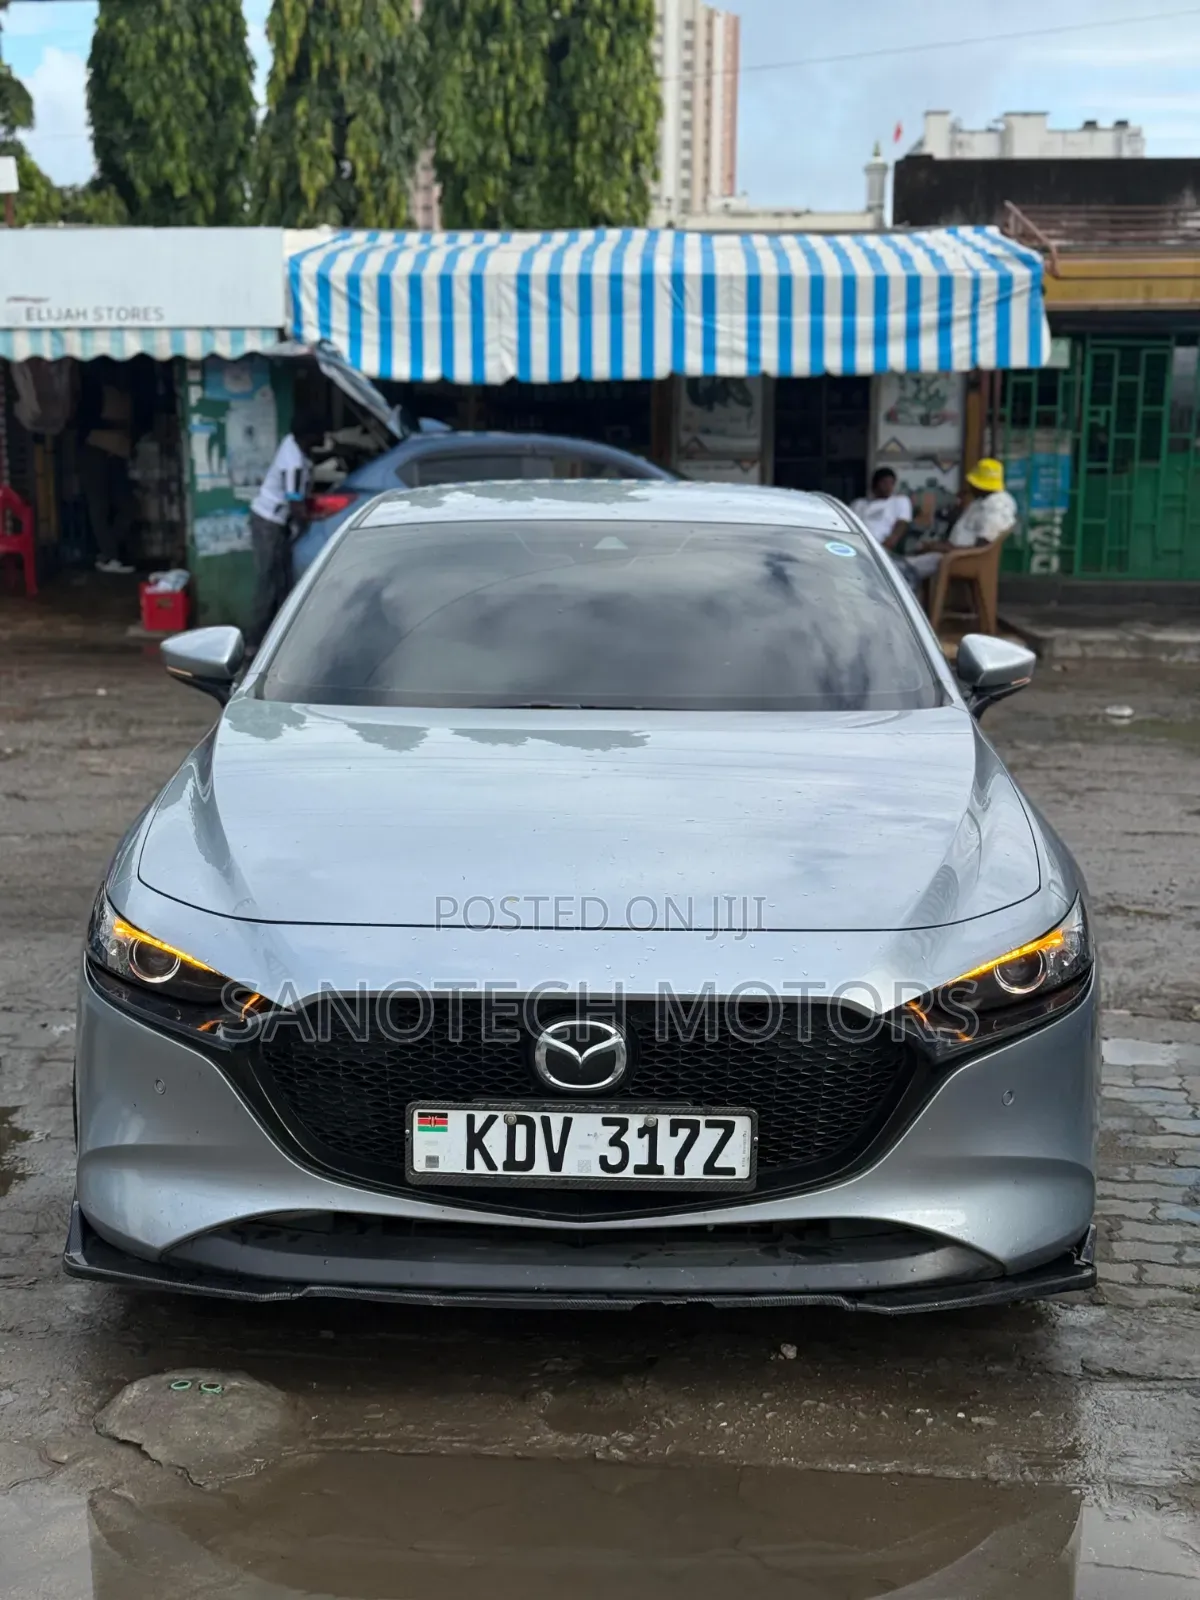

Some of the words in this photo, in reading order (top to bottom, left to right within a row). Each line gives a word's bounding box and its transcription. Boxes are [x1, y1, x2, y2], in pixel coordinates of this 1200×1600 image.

[25, 306, 87, 322] ELIJAH
[92, 305, 165, 322] STORES
[466, 1113, 574, 1173] KDV
[599, 1116, 736, 1177] 317Z
